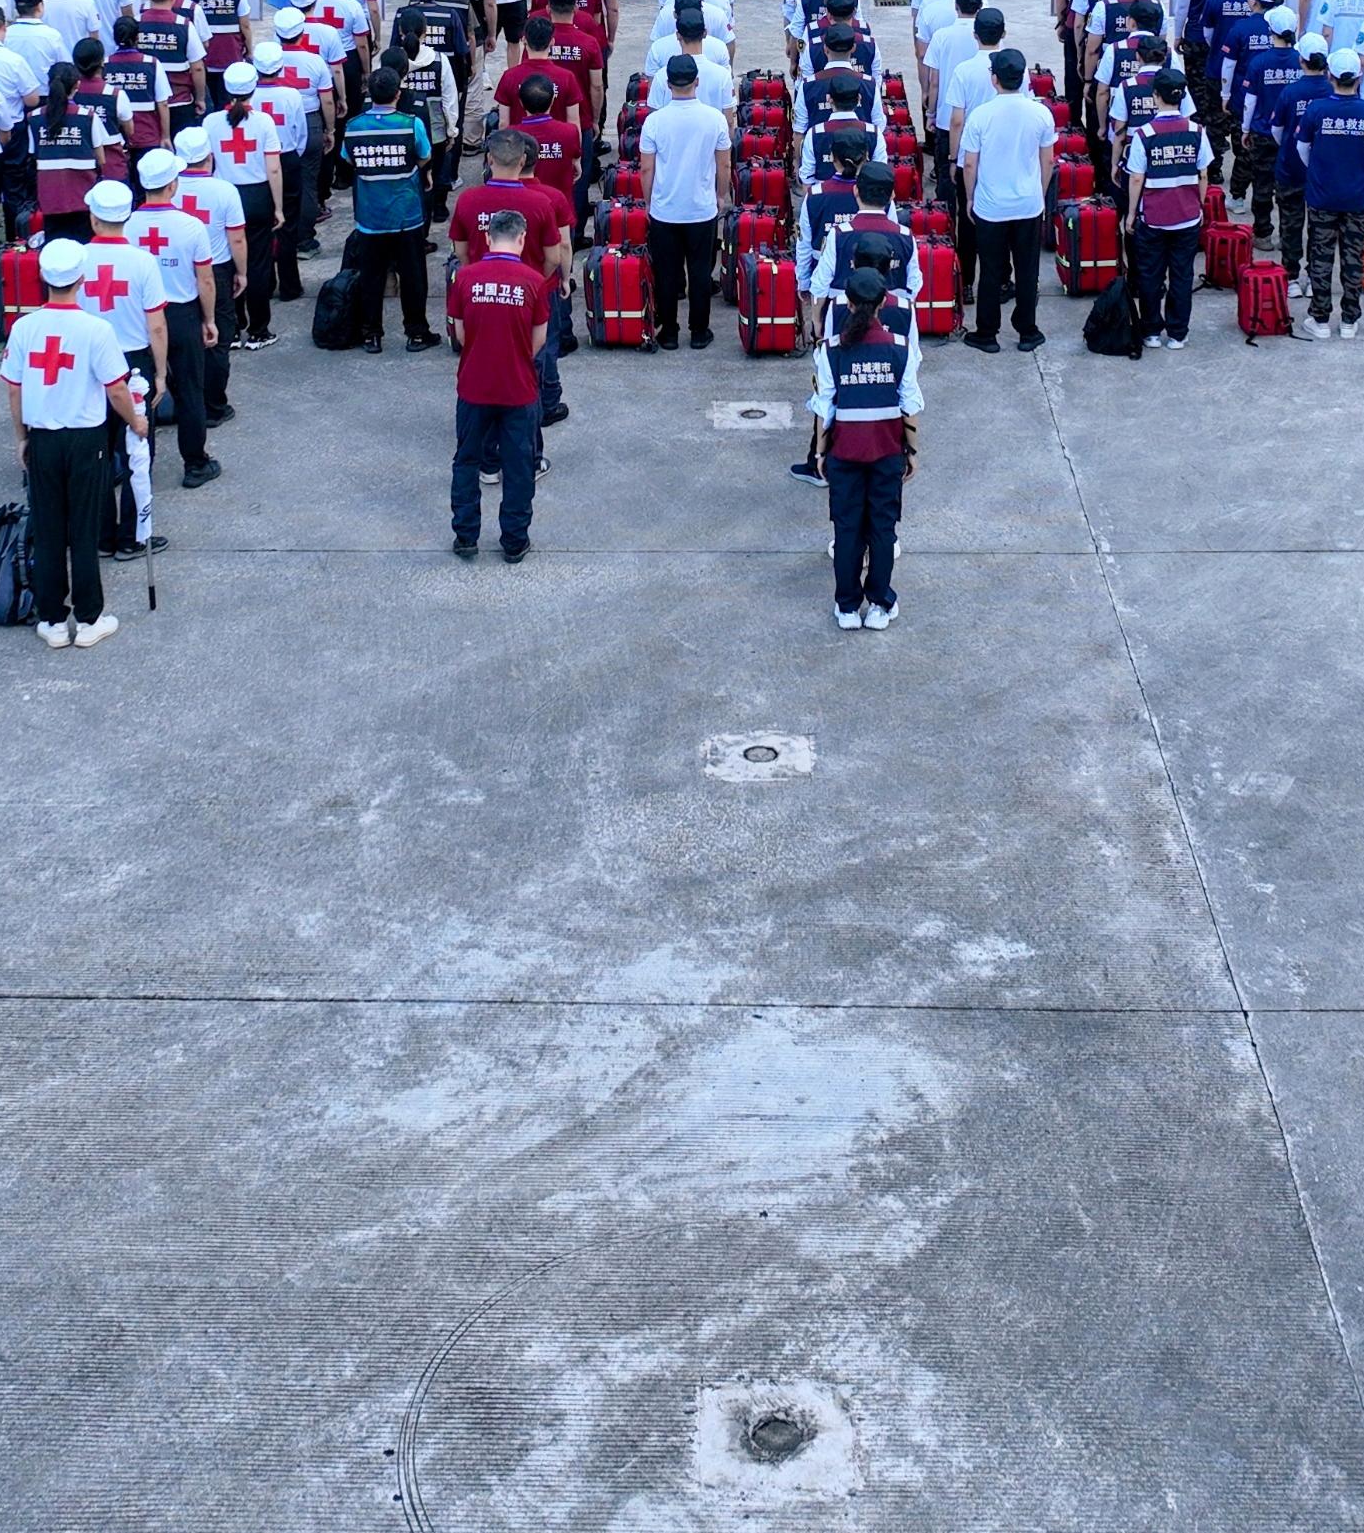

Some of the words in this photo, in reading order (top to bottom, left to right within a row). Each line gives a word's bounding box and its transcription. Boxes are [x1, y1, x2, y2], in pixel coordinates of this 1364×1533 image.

[138, 33, 178, 44] 北海卫生
[105, 73, 147, 84] 北海卫生
[540, 143, 562, 153] 卫生
[1150, 144, 1196, 159] 中国卫生
[472, 282, 524, 300] 中国卫生
[472, 296, 494, 304] CHINA
[496, 297, 524, 307] HEALTH
[851, 362, 891, 374] 防城港市
